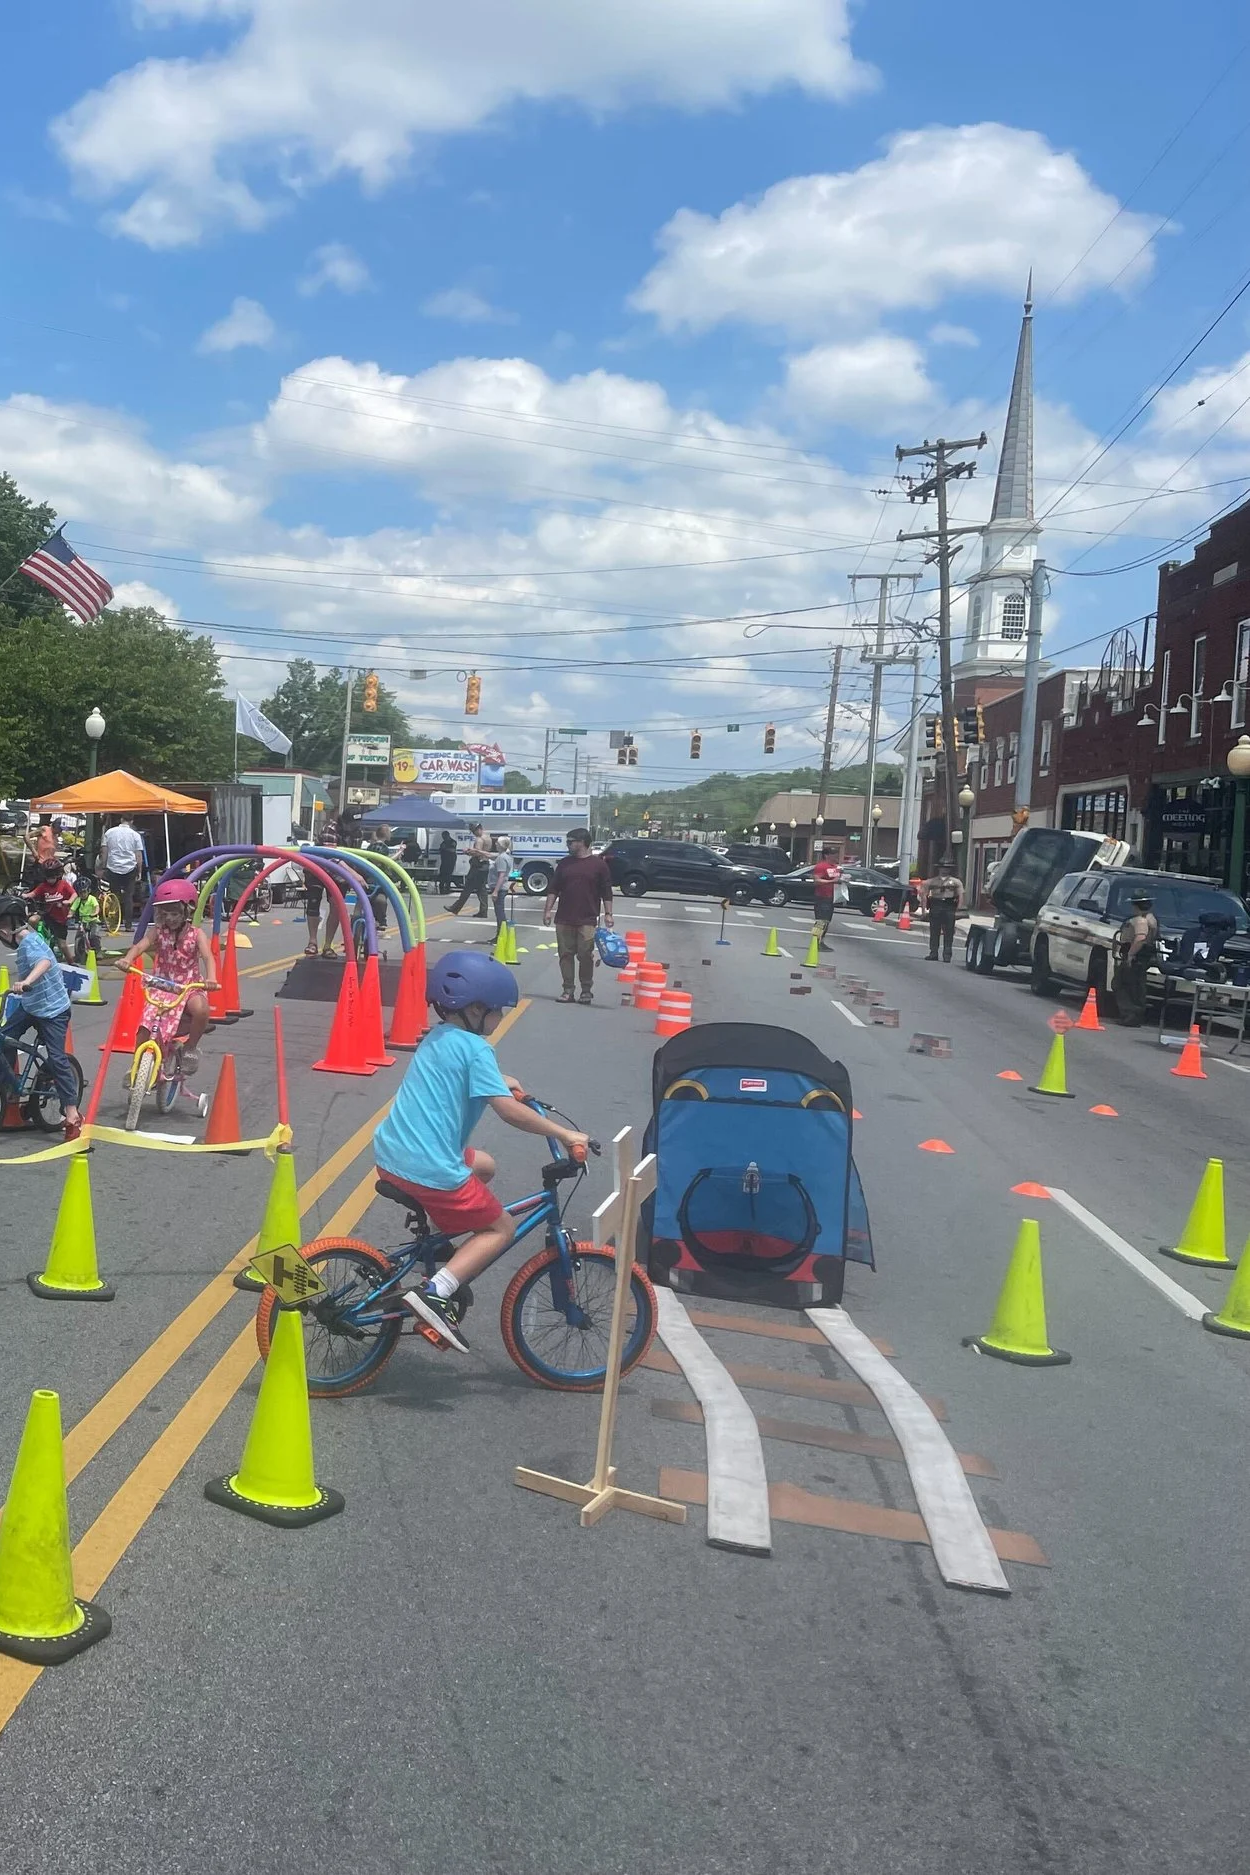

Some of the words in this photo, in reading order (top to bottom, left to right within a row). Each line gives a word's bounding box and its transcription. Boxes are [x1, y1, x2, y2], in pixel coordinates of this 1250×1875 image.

[420, 760, 444, 772] CAR
[448, 760, 478, 773] WASH
[423, 772, 475, 782] EXPRESS
[478, 798, 547, 812] POLICE
[1162, 813, 1206, 823] MEETING
